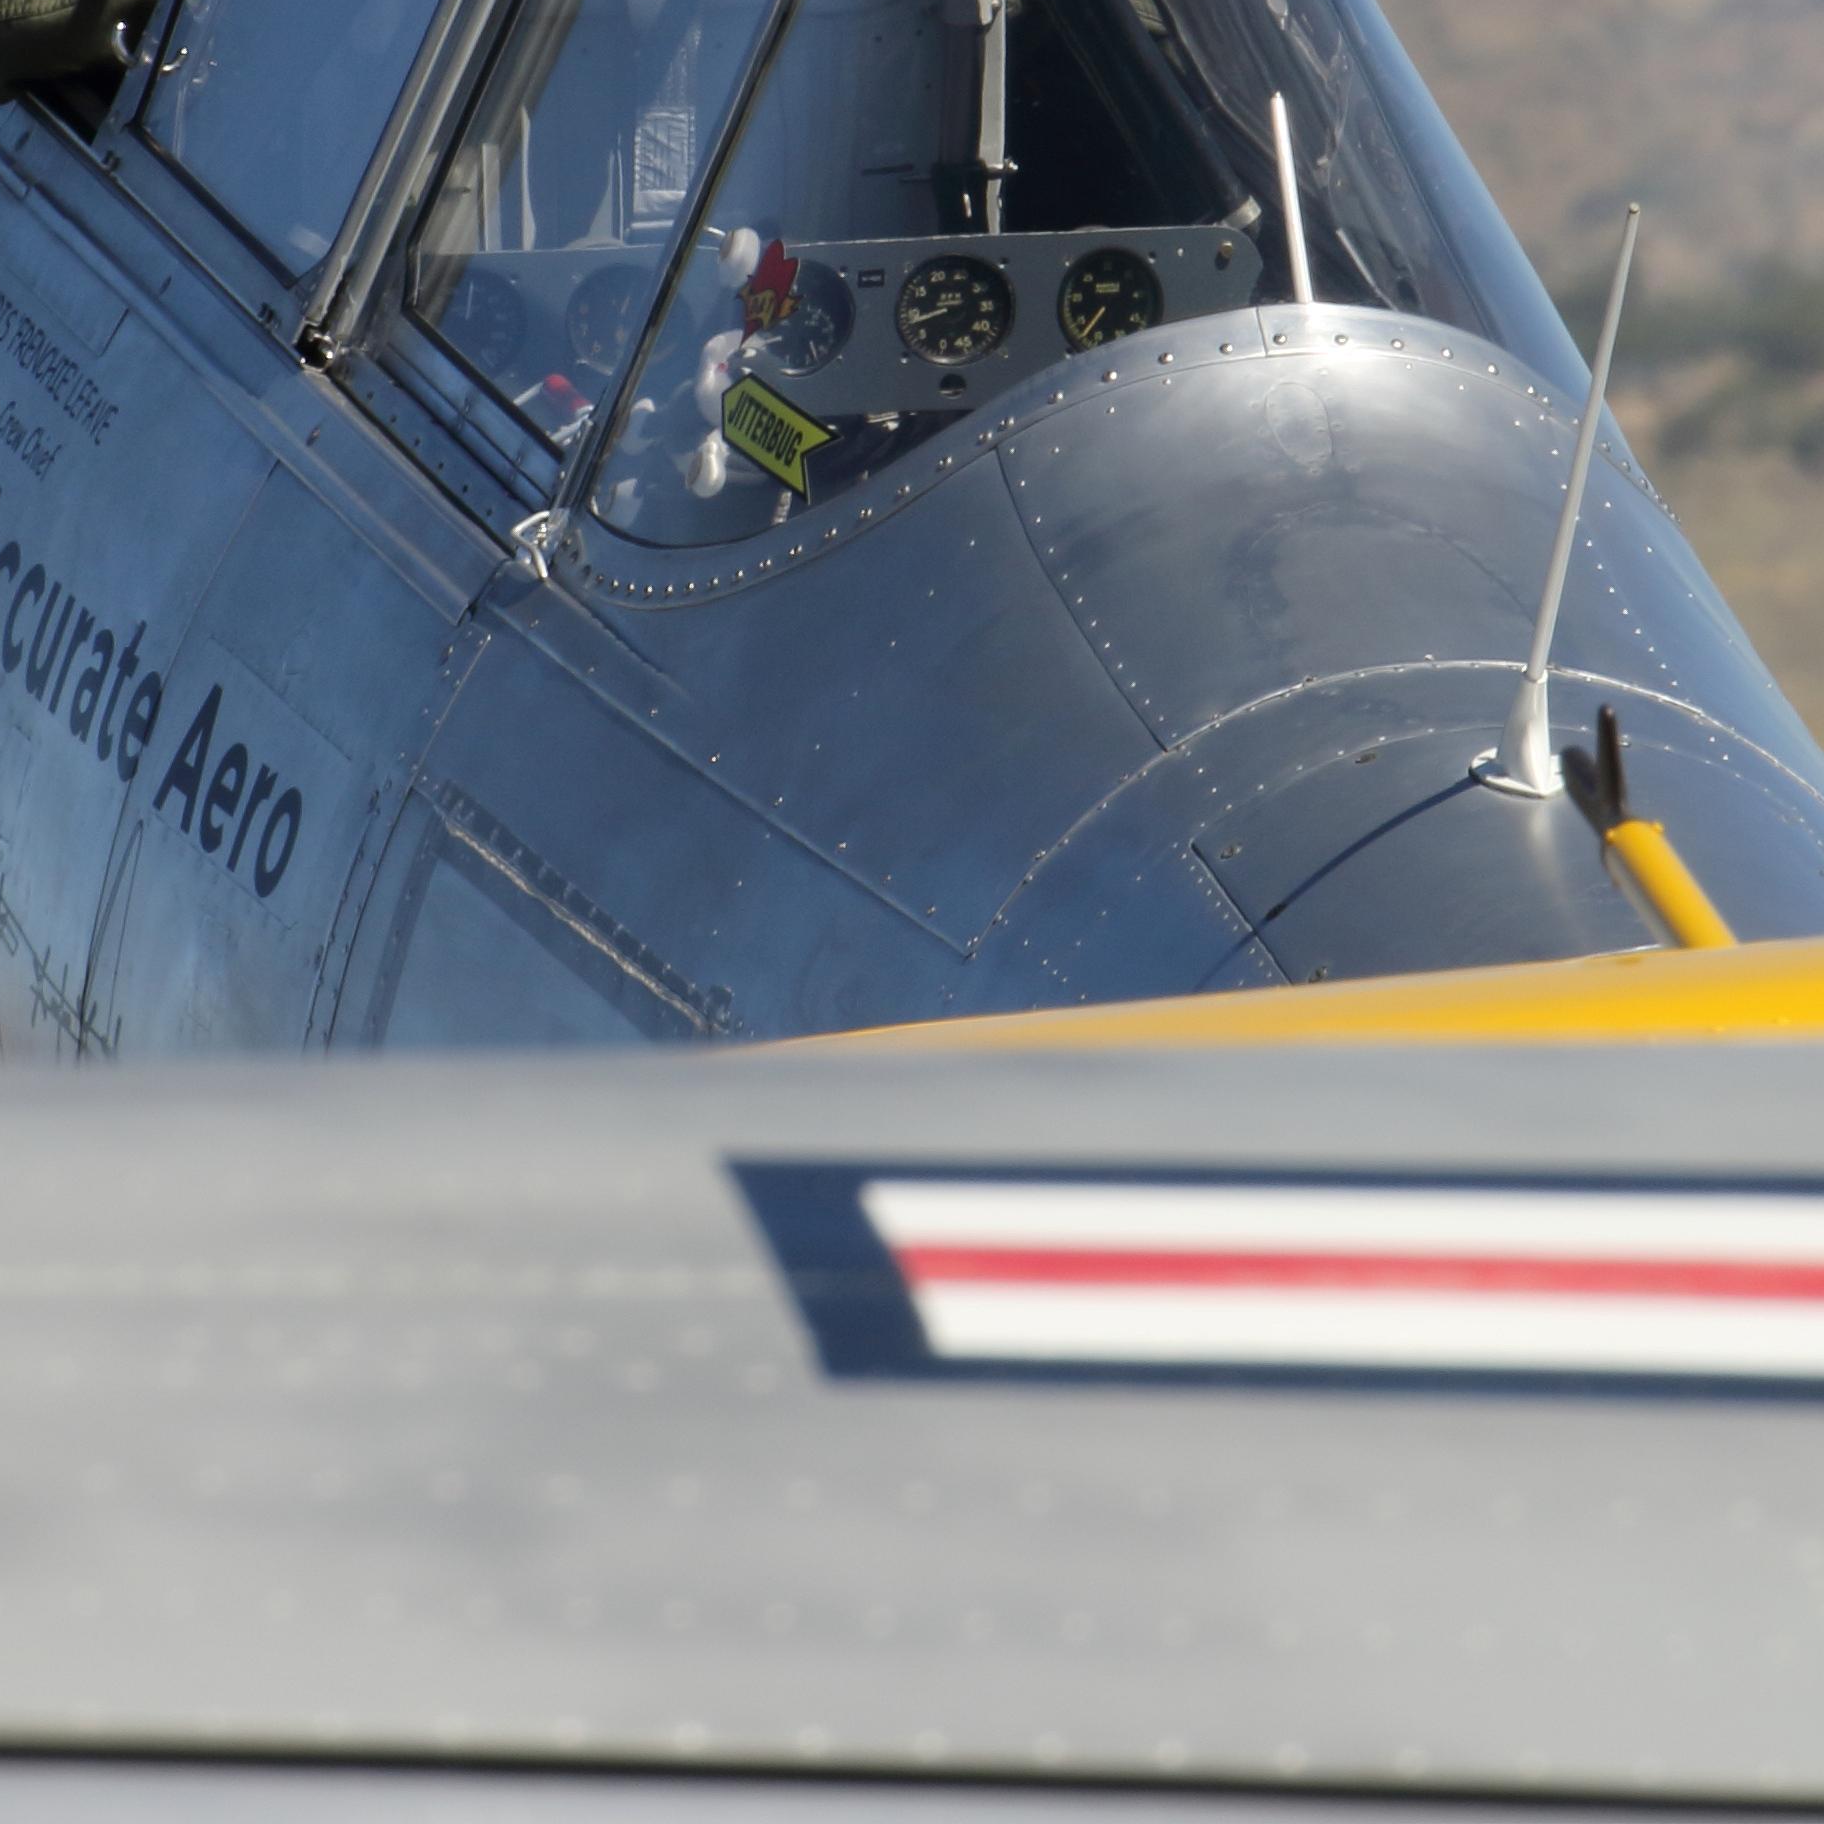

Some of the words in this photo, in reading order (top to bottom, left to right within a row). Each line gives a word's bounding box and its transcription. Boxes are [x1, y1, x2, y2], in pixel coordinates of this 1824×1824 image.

[953, 335, 973, 349] 45
[971, 319, 991, 332] 40
[727, 390, 804, 467] JITTERBUG
[152, 683, 303, 898] Aero
